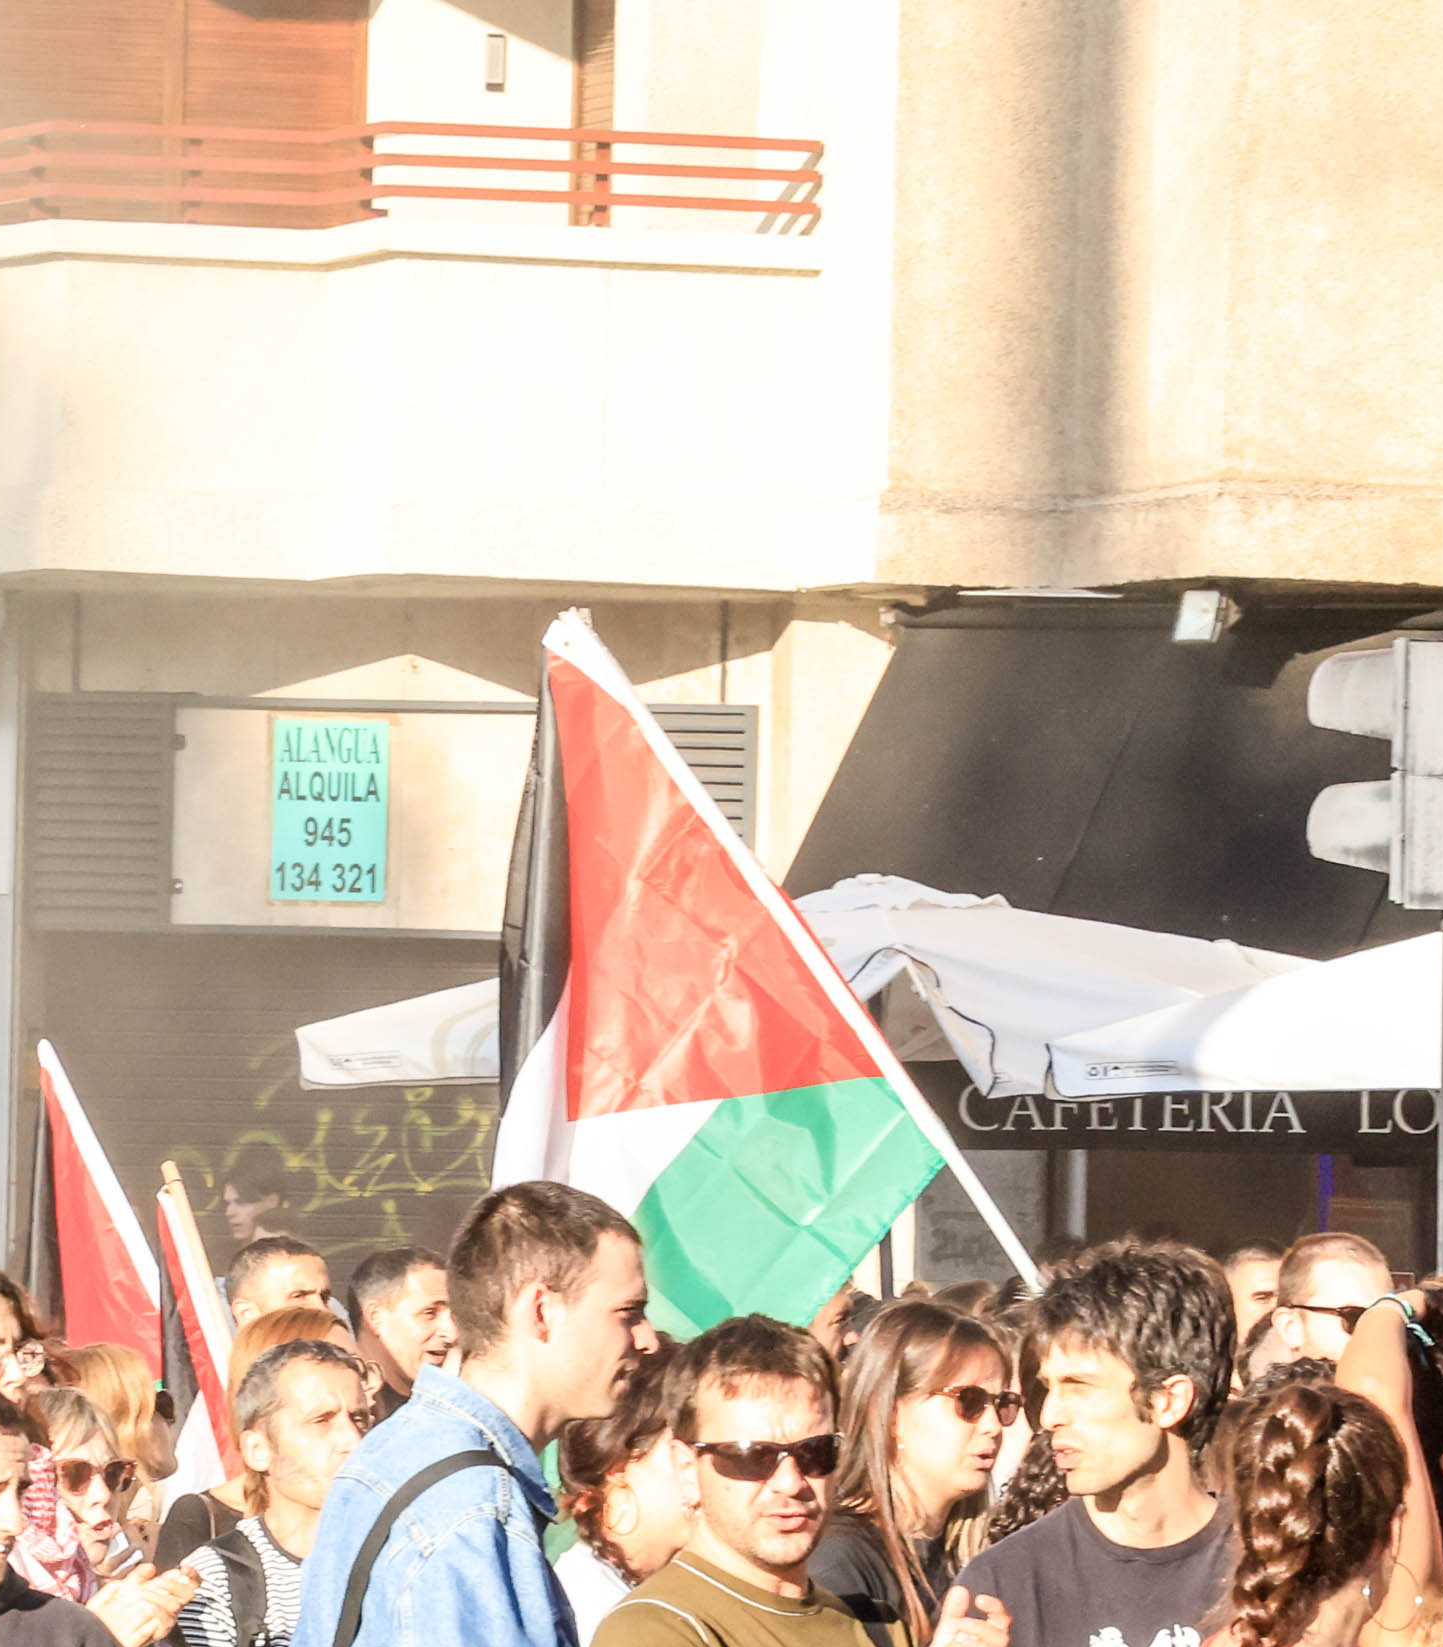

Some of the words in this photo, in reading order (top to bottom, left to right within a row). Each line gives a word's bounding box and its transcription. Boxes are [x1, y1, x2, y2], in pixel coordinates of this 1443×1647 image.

[279, 726, 381, 764] ALANGUA
[277, 770, 381, 803] ALQUILA
[303, 816, 353, 848] 945
[275, 861, 322, 893] 134
[331, 862, 377, 894] 321
